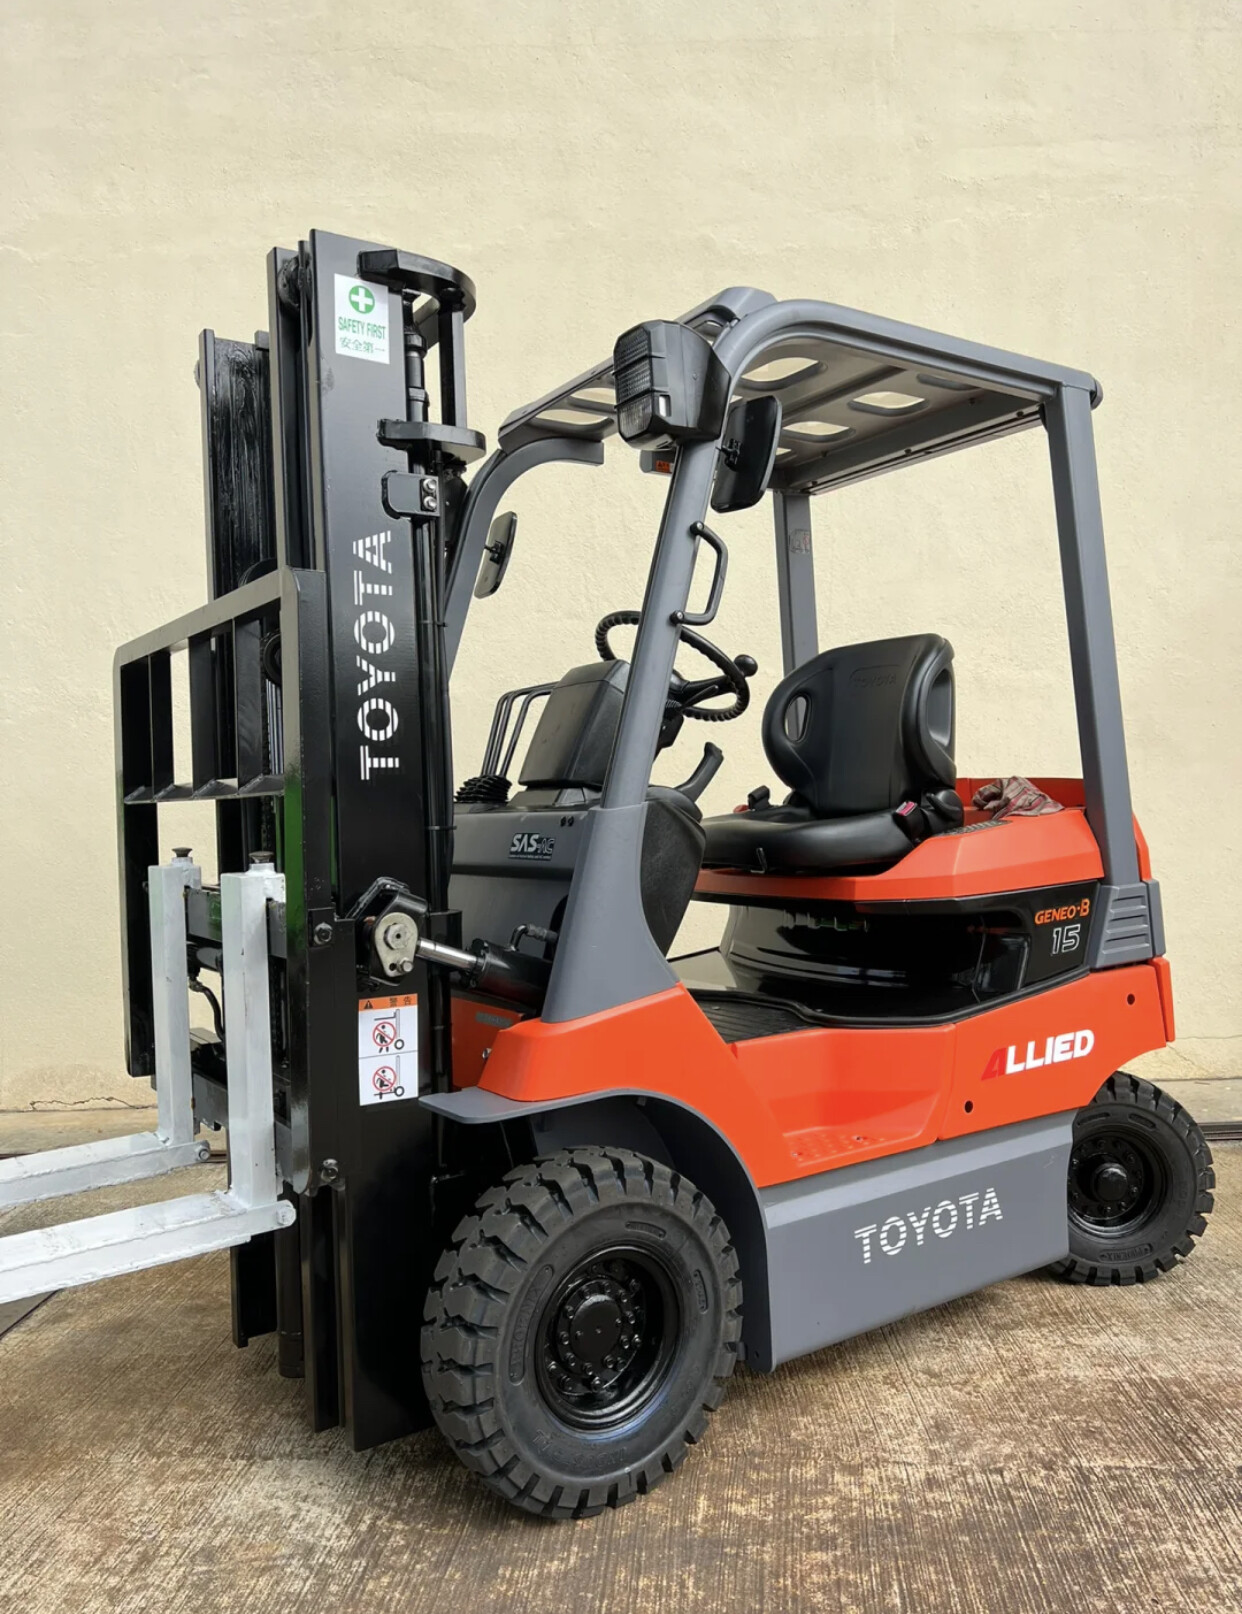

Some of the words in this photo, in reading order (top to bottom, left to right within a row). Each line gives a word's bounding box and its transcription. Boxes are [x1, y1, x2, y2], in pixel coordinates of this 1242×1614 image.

[338, 316, 366, 336] SAFETY
[367, 322, 386, 340] FIRST
[340, 336, 386, 353] 安全第一
[353, 531, 399, 780] TOYOTA
[1052, 923, 1081, 954] 15
[981, 1029, 1095, 1081] ALLIED
[854, 1187, 1004, 1264] TOYOTA
